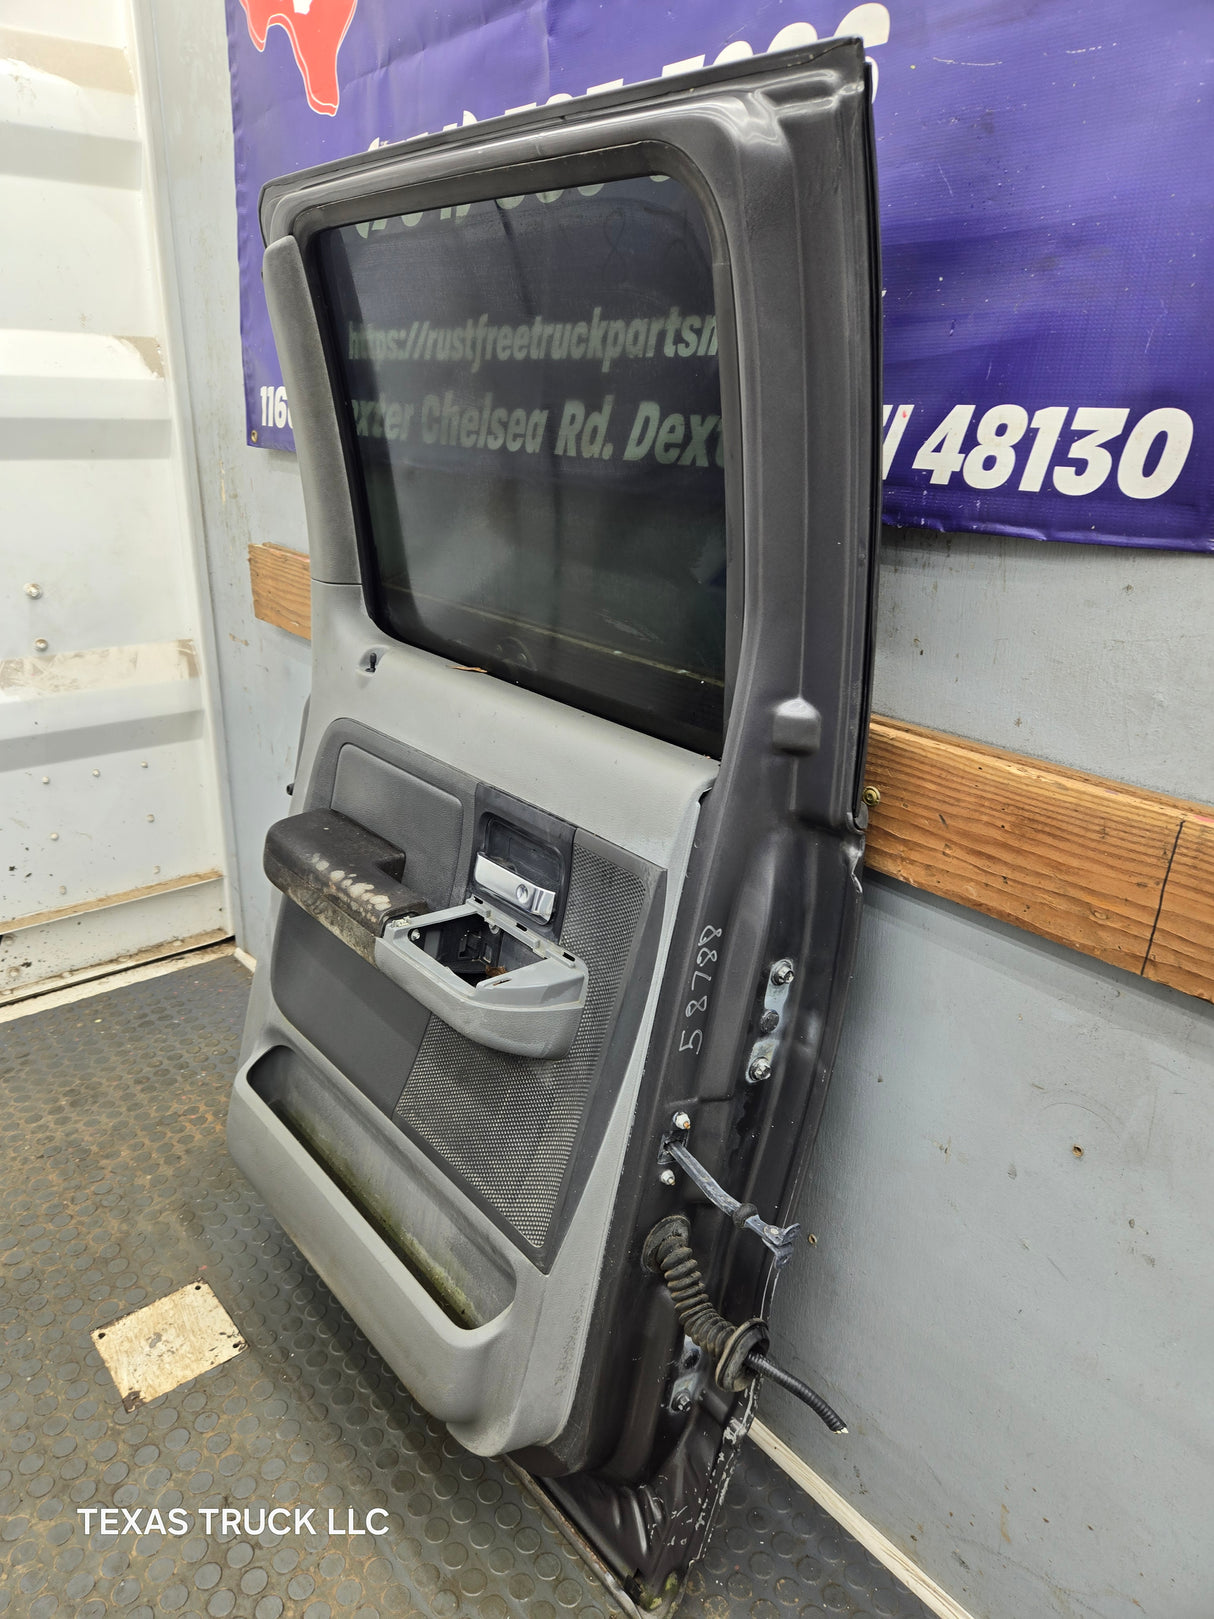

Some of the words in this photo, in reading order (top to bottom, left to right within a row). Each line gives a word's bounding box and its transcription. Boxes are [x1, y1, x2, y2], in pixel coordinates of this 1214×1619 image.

[260, 386, 293, 429] 116
[351, 391, 414, 441] xter
[421, 390, 549, 453] Chelsea
[554, 394, 614, 460] Rd.
[911, 403, 1194, 499] 48130
[678, 925, 722, 1055] 58788
